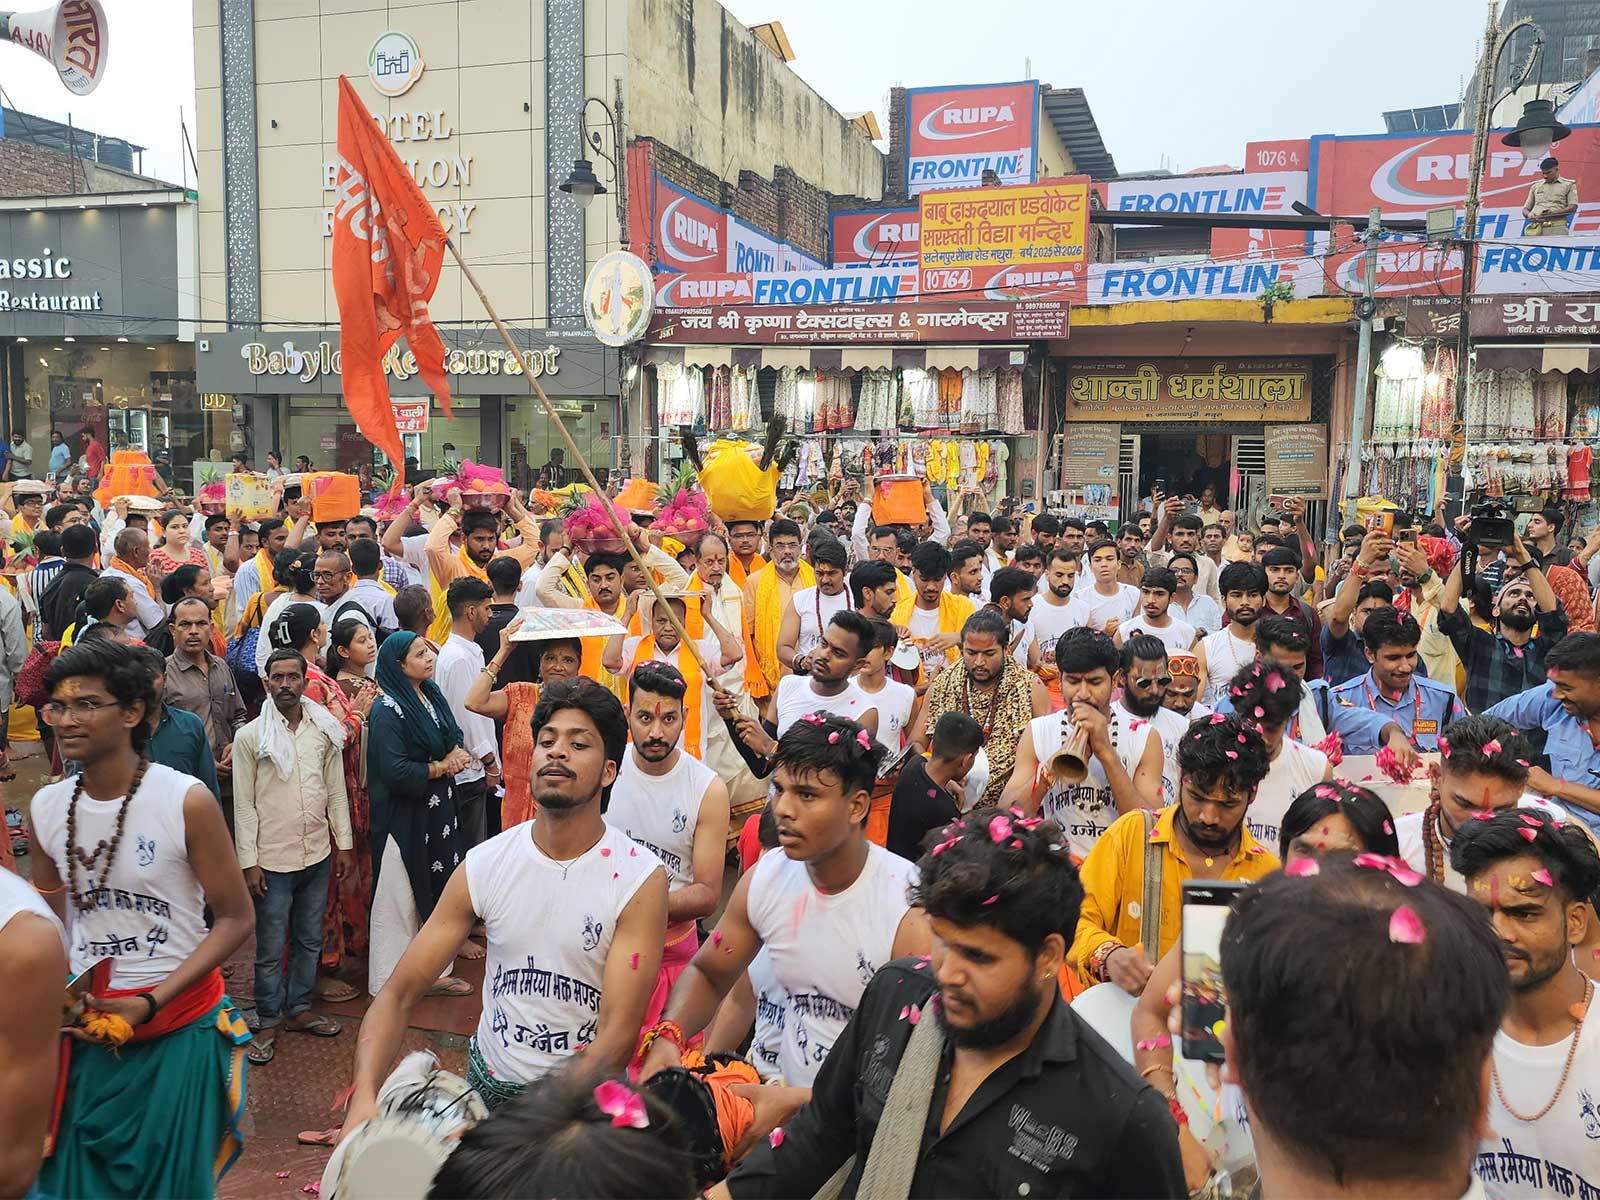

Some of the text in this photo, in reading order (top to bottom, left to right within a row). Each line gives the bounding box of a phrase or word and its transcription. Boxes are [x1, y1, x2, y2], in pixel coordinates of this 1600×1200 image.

[11, 26, 52, 60] AJAY
[371, 110, 453, 142] OTEL
[943, 105, 1015, 125] RUPA
[924, 202, 954, 225] बाबू
[1119, 186, 1287, 214] FRONTLINE
[674, 211, 719, 253] RUPA
[879, 222, 920, 243] RU
[923, 216, 1074, 247] सरस्वती विद्या मन्दिर
[679, 279, 753, 299] RUPA
[754, 274, 918, 305] FRONTLINE
[1005, 270, 1077, 288] RUPA
[0, 290, 103, 313] Restaurant
[1502, 297, 1554, 324] श्री
[680, 315, 714, 329] जय
[716, 310, 741, 329] श्री
[743, 314, 792, 335] कृष्णा
[898, 312, 912, 327] &
[240, 341, 561, 383] Babylo Reaurant
[1070, 362, 1306, 402] शान्ती धर्मशाला
[1464, 550, 1473, 575] Canon
